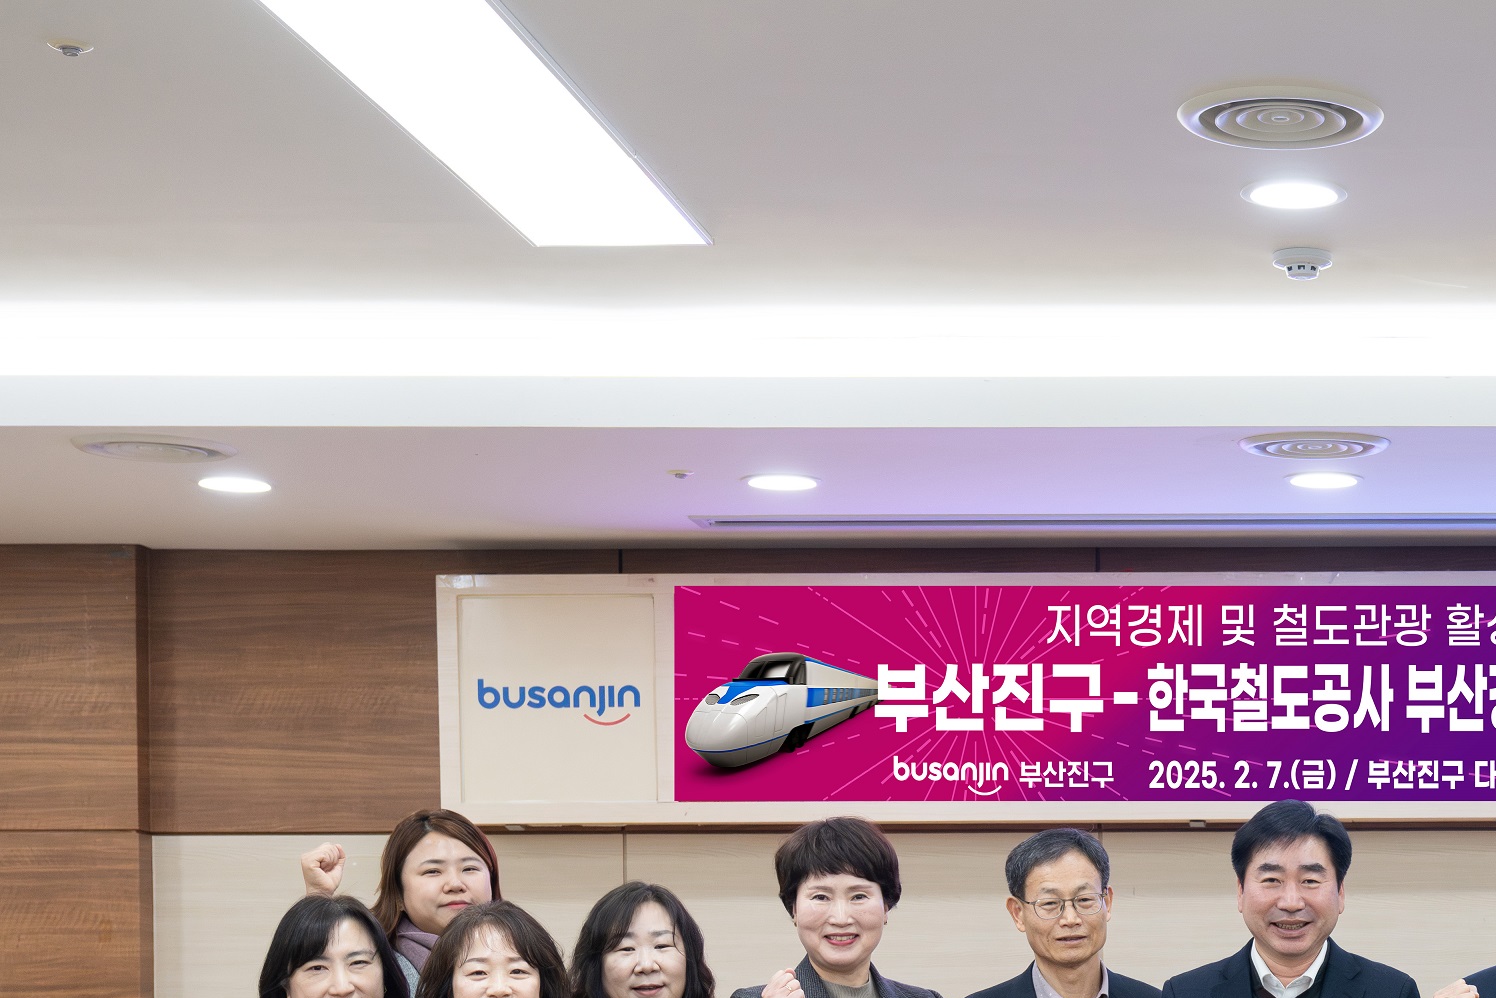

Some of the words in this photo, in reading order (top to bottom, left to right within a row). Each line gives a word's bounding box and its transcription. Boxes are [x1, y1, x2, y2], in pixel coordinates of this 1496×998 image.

[1047, 604, 1202, 647] 지역경제
[1221, 604, 1255, 647] 및
[1273, 603, 1432, 647] 철도관광
[477, 678, 641, 717] busanjin
[893, 755, 1009, 789] busanjin
[1019, 761, 1114, 789] 부산진구
[1148, 760, 1225, 790] 2025.
[1234, 760, 1258, 790] 2.
[1266, 759, 1336, 790] 7.(금)
[1367, 760, 1465, 790] 부산진구
